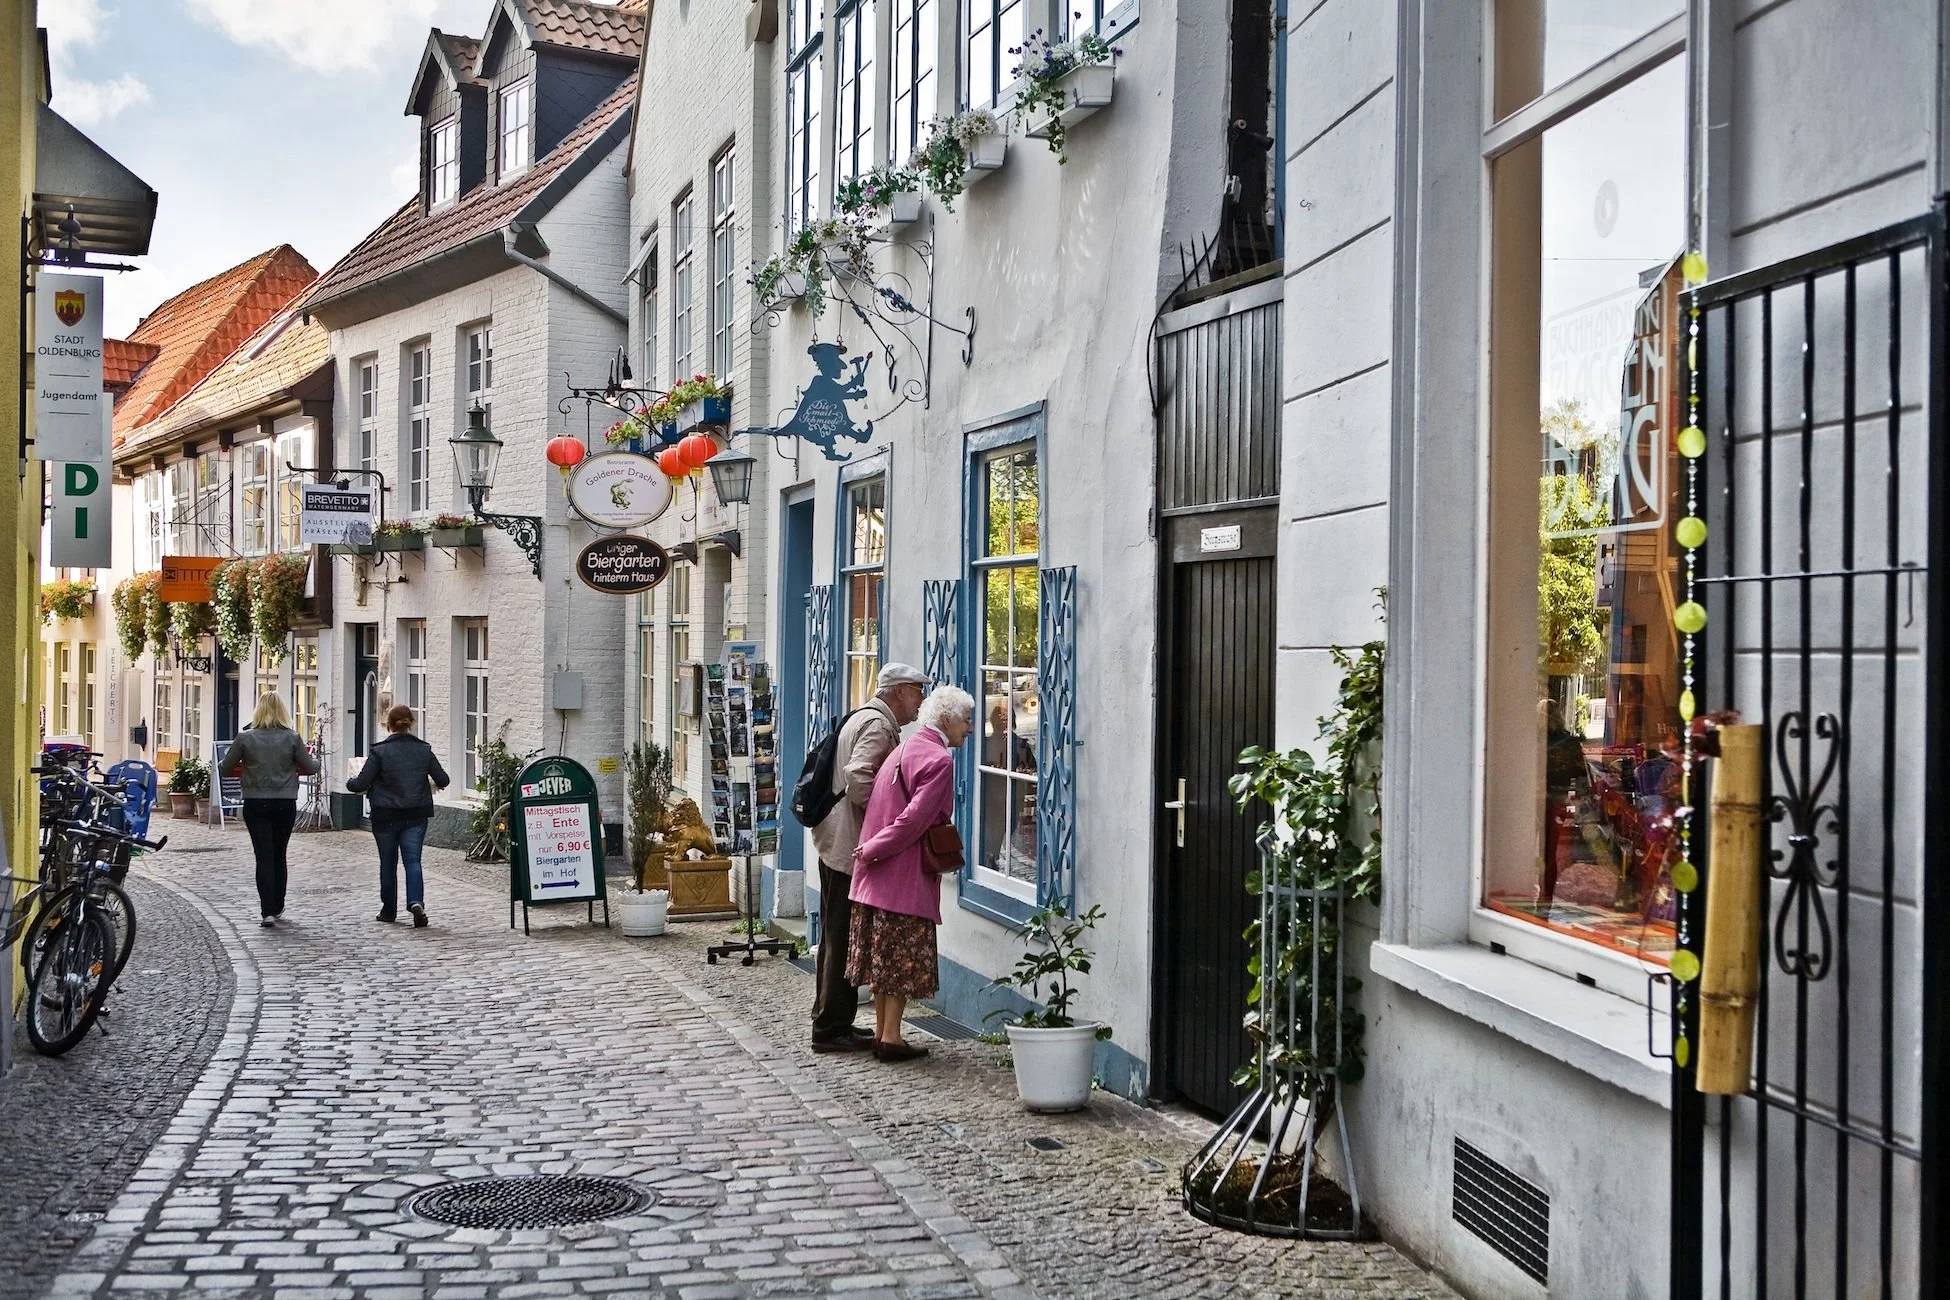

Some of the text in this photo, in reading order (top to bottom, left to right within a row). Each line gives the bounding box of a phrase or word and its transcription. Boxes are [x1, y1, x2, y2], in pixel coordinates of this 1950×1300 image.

[54, 335, 85, 345] STADT
[37, 346, 101, 358] OLDENBURG
[41, 389, 98, 401] Jugendamt
[585, 467, 657, 487] Goldener Drache
[307, 494, 359, 505] BREVETTO
[606, 543, 638, 556] uriger
[587, 552, 660, 573] Biergarten
[593, 571, 655, 583] hinterm Haus
[539, 776, 573, 795] JEVER
[525, 805, 581, 817] Mittagstisch
[552, 818, 579, 828] Ente
[545, 829, 586, 842] Vorspeise
[538, 845, 553, 854] nur
[557, 841, 581, 853] 6,90
[536, 855, 581, 866] Biergarten
[560, 867, 577, 877] Hof
